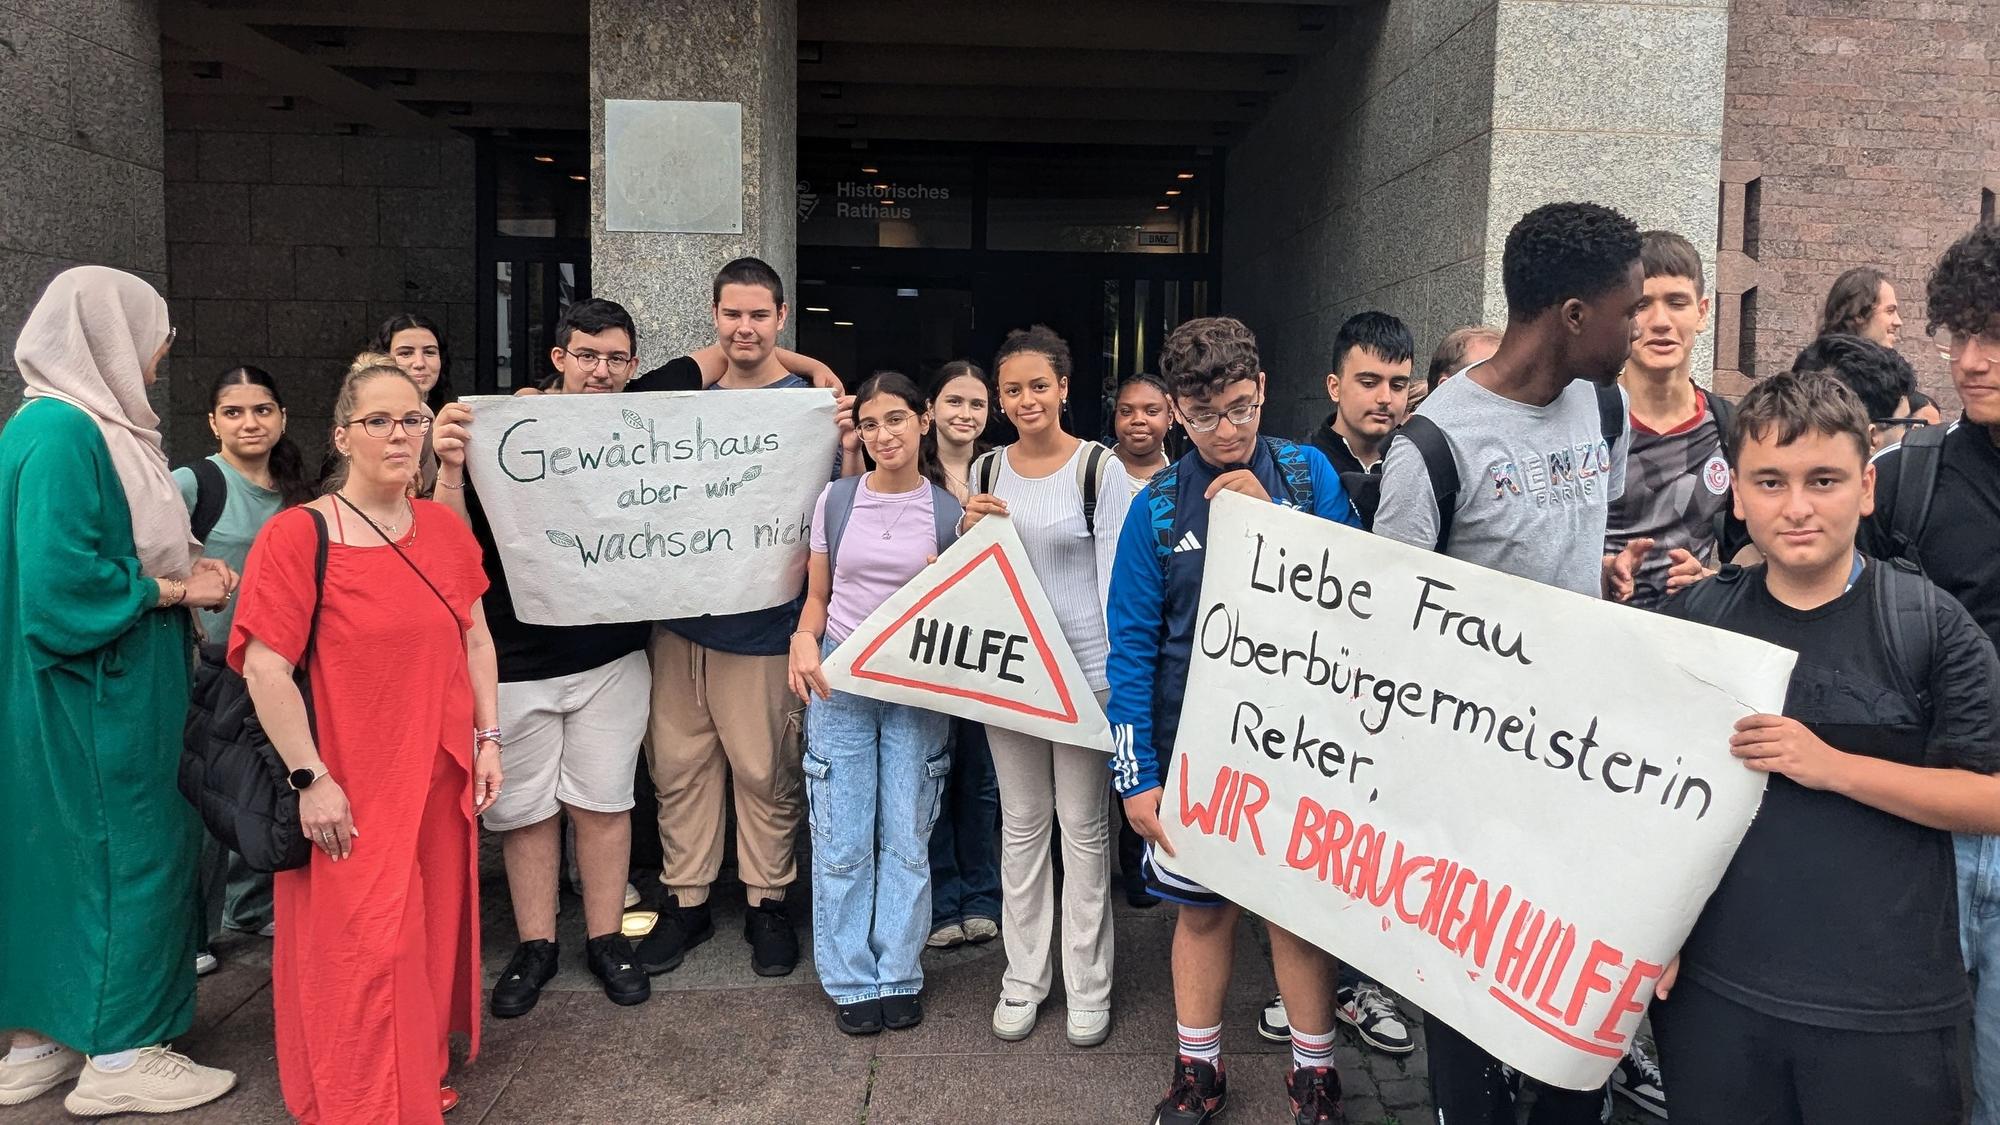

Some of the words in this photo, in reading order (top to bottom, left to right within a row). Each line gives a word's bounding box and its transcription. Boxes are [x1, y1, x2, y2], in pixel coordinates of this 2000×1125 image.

[837, 182, 949, 199] Historisches
[837, 203, 911, 218] Rathaus
[498, 417, 779, 483] Gewächshaus
[616, 480, 688, 509] aber
[705, 476, 744, 498] wir
[1535, 480, 1593, 508] PARIS
[753, 513, 811, 549] nich
[1250, 532, 1373, 621] Liebe
[1412, 575, 1533, 666] Frau
[908, 617, 1028, 684] HILFE
[1200, 602, 1714, 823] Oberbürgermeisterin
[1231, 701, 1379, 804] Reker,
[1178, 752, 1271, 857] WIR
[1285, 796, 1512, 970] BRAUCHEN
[1494, 900, 1663, 1044] HILFE
